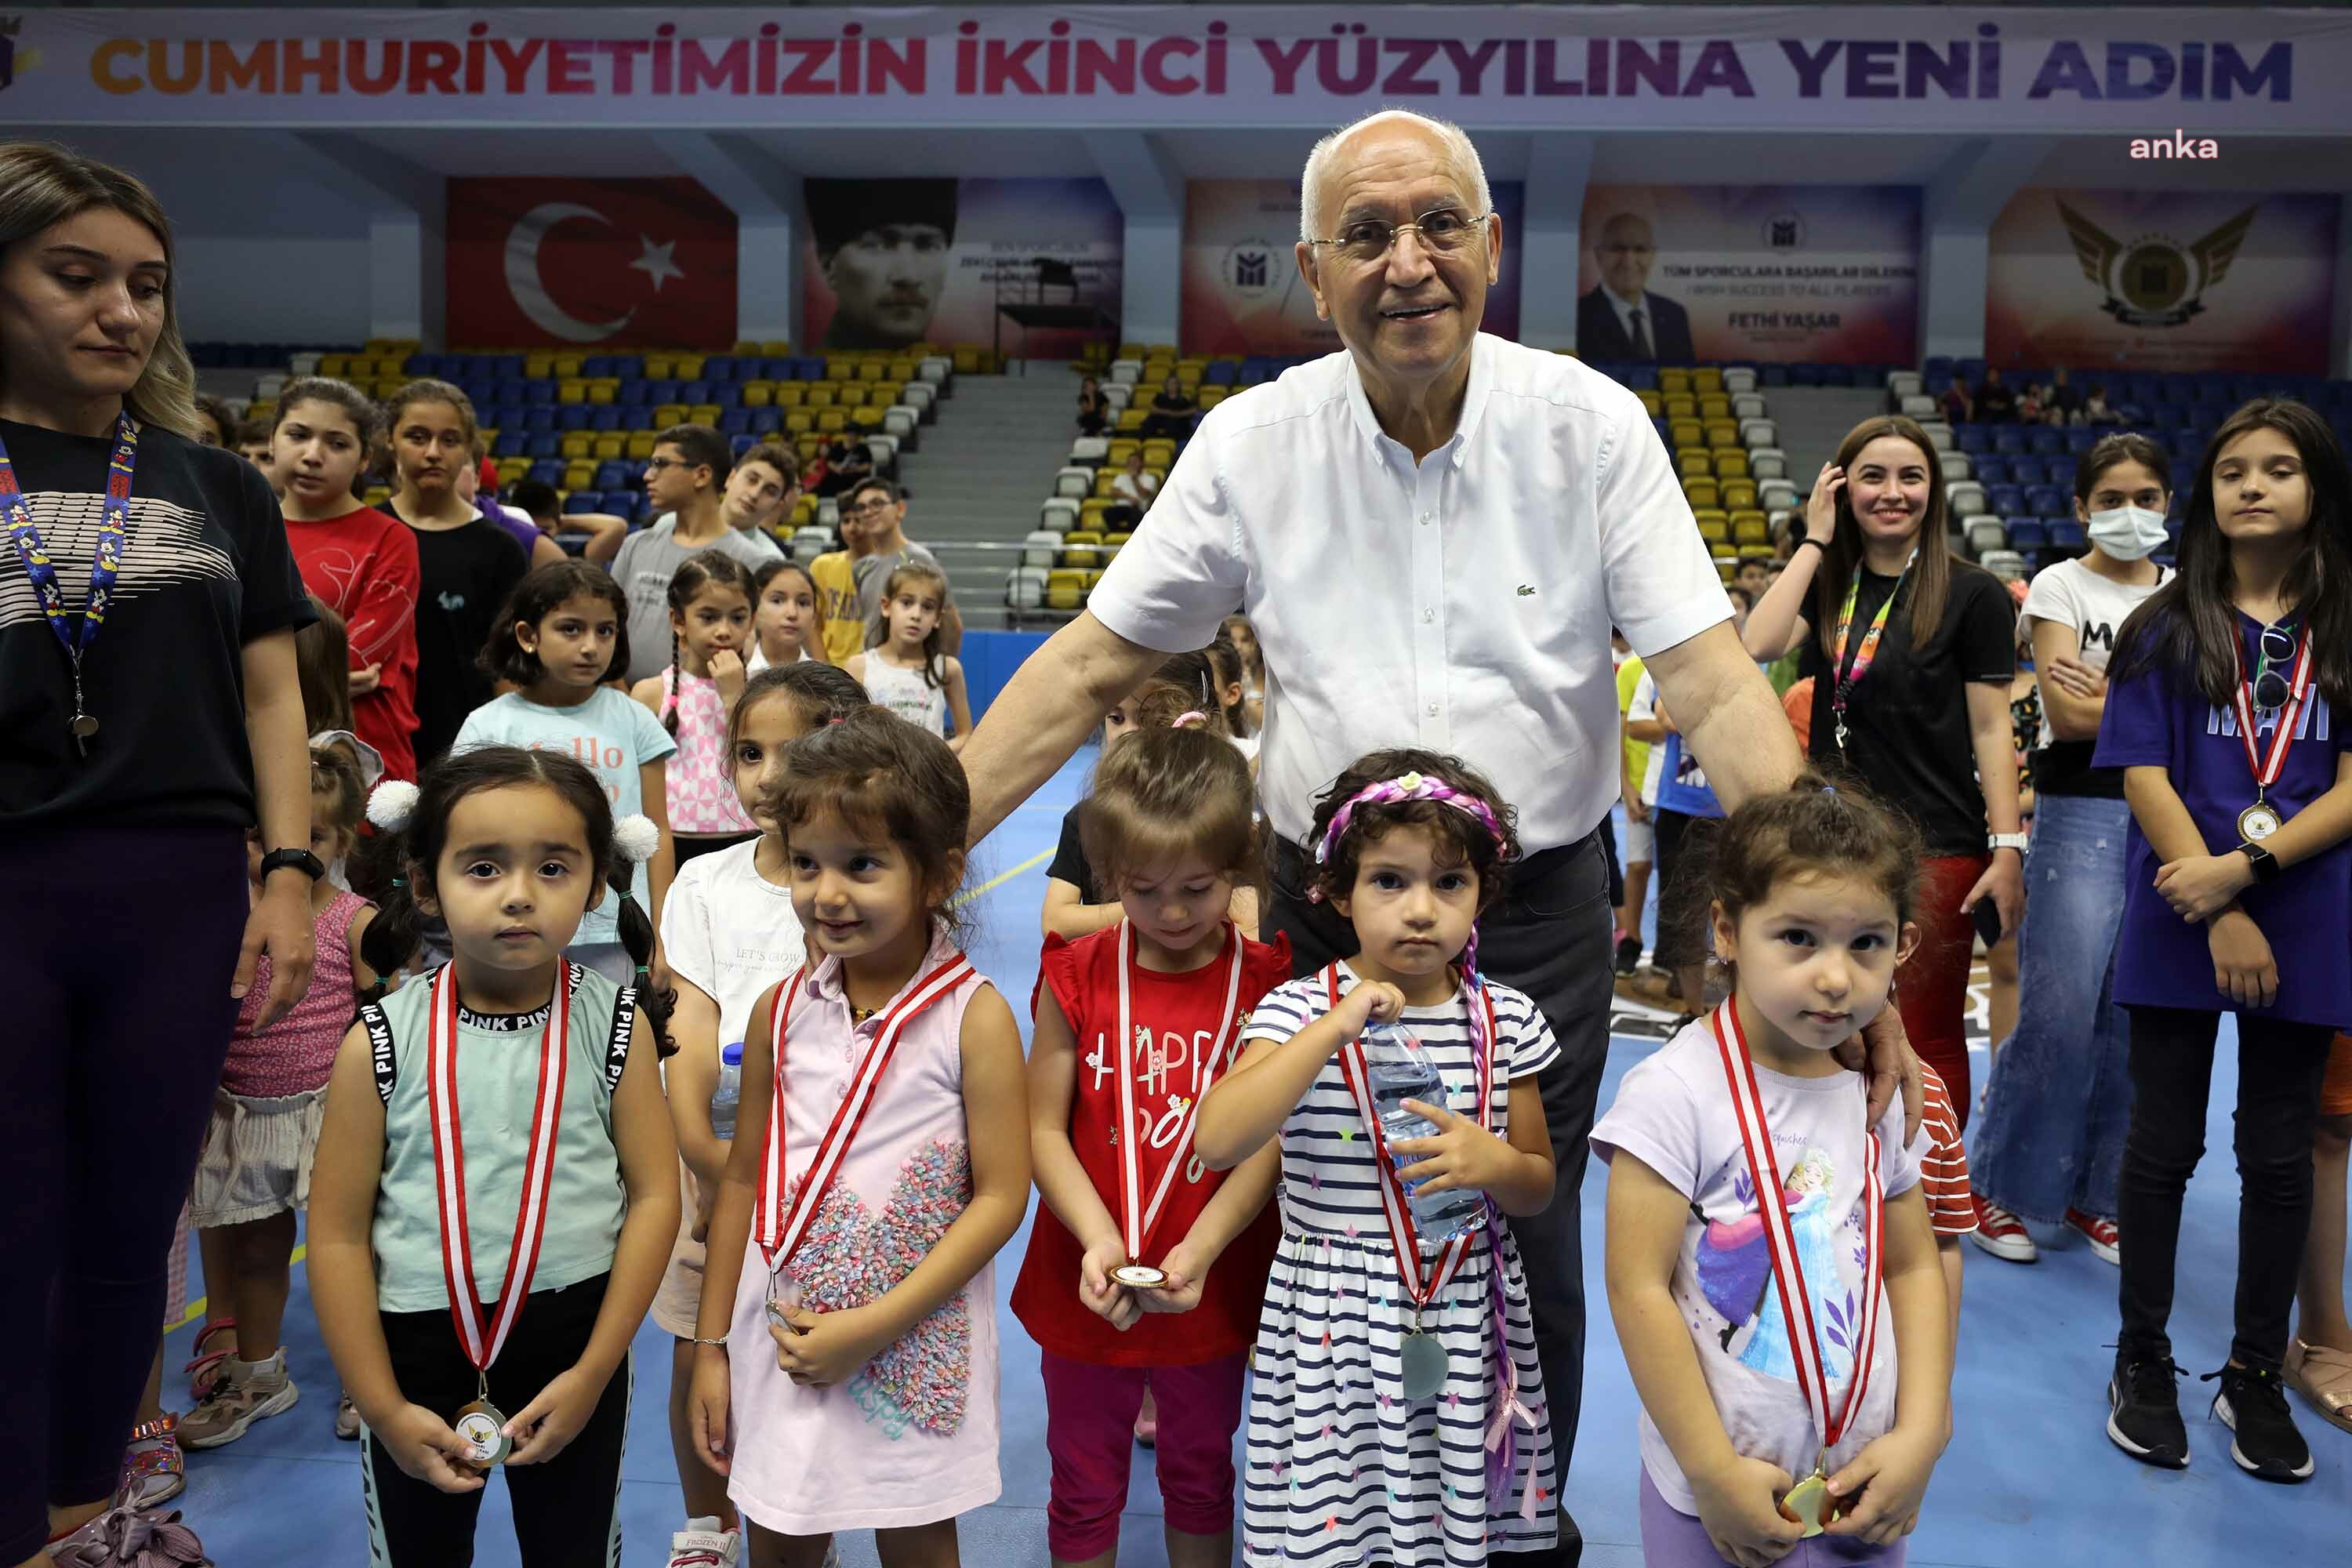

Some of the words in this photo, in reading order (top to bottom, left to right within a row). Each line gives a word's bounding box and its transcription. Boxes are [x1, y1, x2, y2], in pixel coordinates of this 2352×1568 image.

[89, 21, 927, 95] CUMHURİYETİMİZİN
[955, 20, 1229, 95] İKİNCİ
[1256, 22, 1755, 97] YÜZYILINA
[1777, 21, 2001, 99] YENİ
[2027, 41, 2293, 102] ADIM
[1663, 264, 1693, 278] TÜM
[1729, 310, 1778, 327] FETHİ
[1784, 312, 1840, 331] YAŞAR
[458, 1007, 509, 1031] PINK
[516, 1005, 552, 1029] PIN
[612, 1011, 633, 1058] PINK
[370, 1024, 392, 1074] PINK
[686, 1538, 718, 1547] FROZEN
